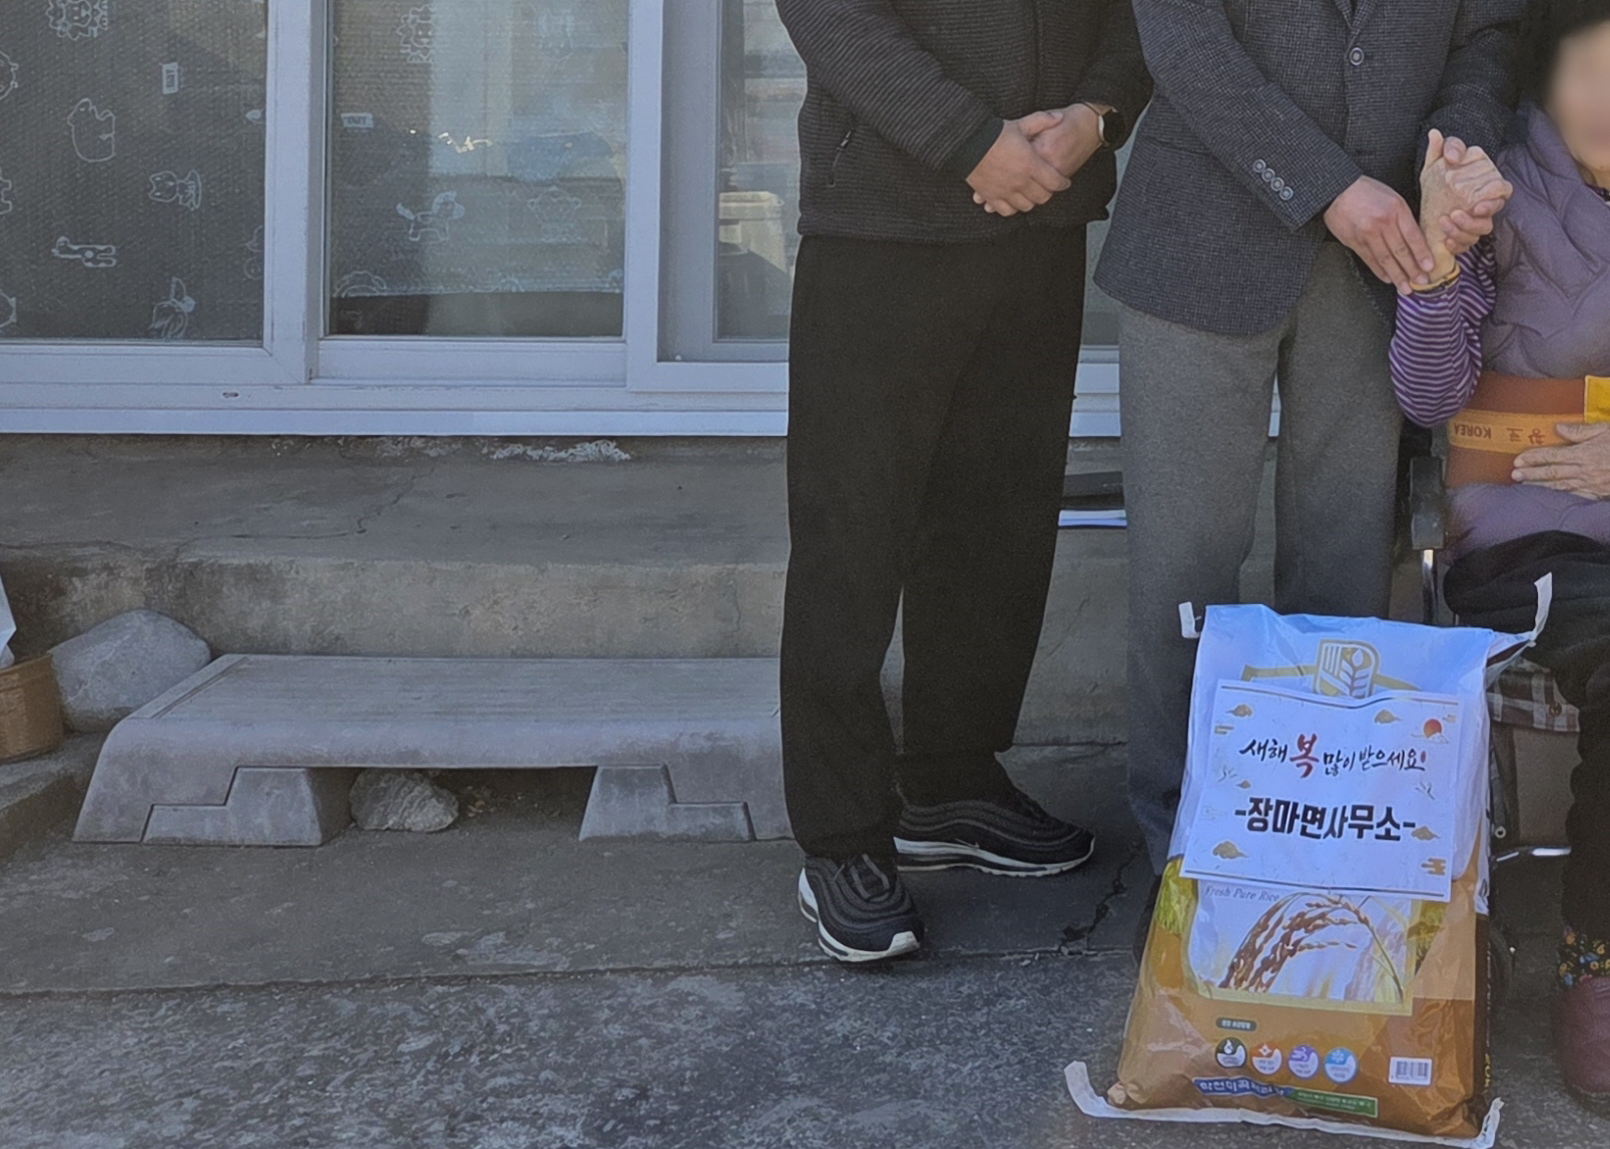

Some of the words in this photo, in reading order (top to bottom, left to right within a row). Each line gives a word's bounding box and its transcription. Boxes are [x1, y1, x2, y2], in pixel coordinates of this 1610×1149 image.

[1453, 422, 1492, 440] KOREA
[1239, 738, 1288, 763] 새해
[1289, 733, 1320, 778] 복
[1323, 749, 1356, 776] 많이
[1204, 884, 1231, 898] Fresh
[1233, 887, 1257, 900] Pure
[1258, 890, 1281, 902] Rice
